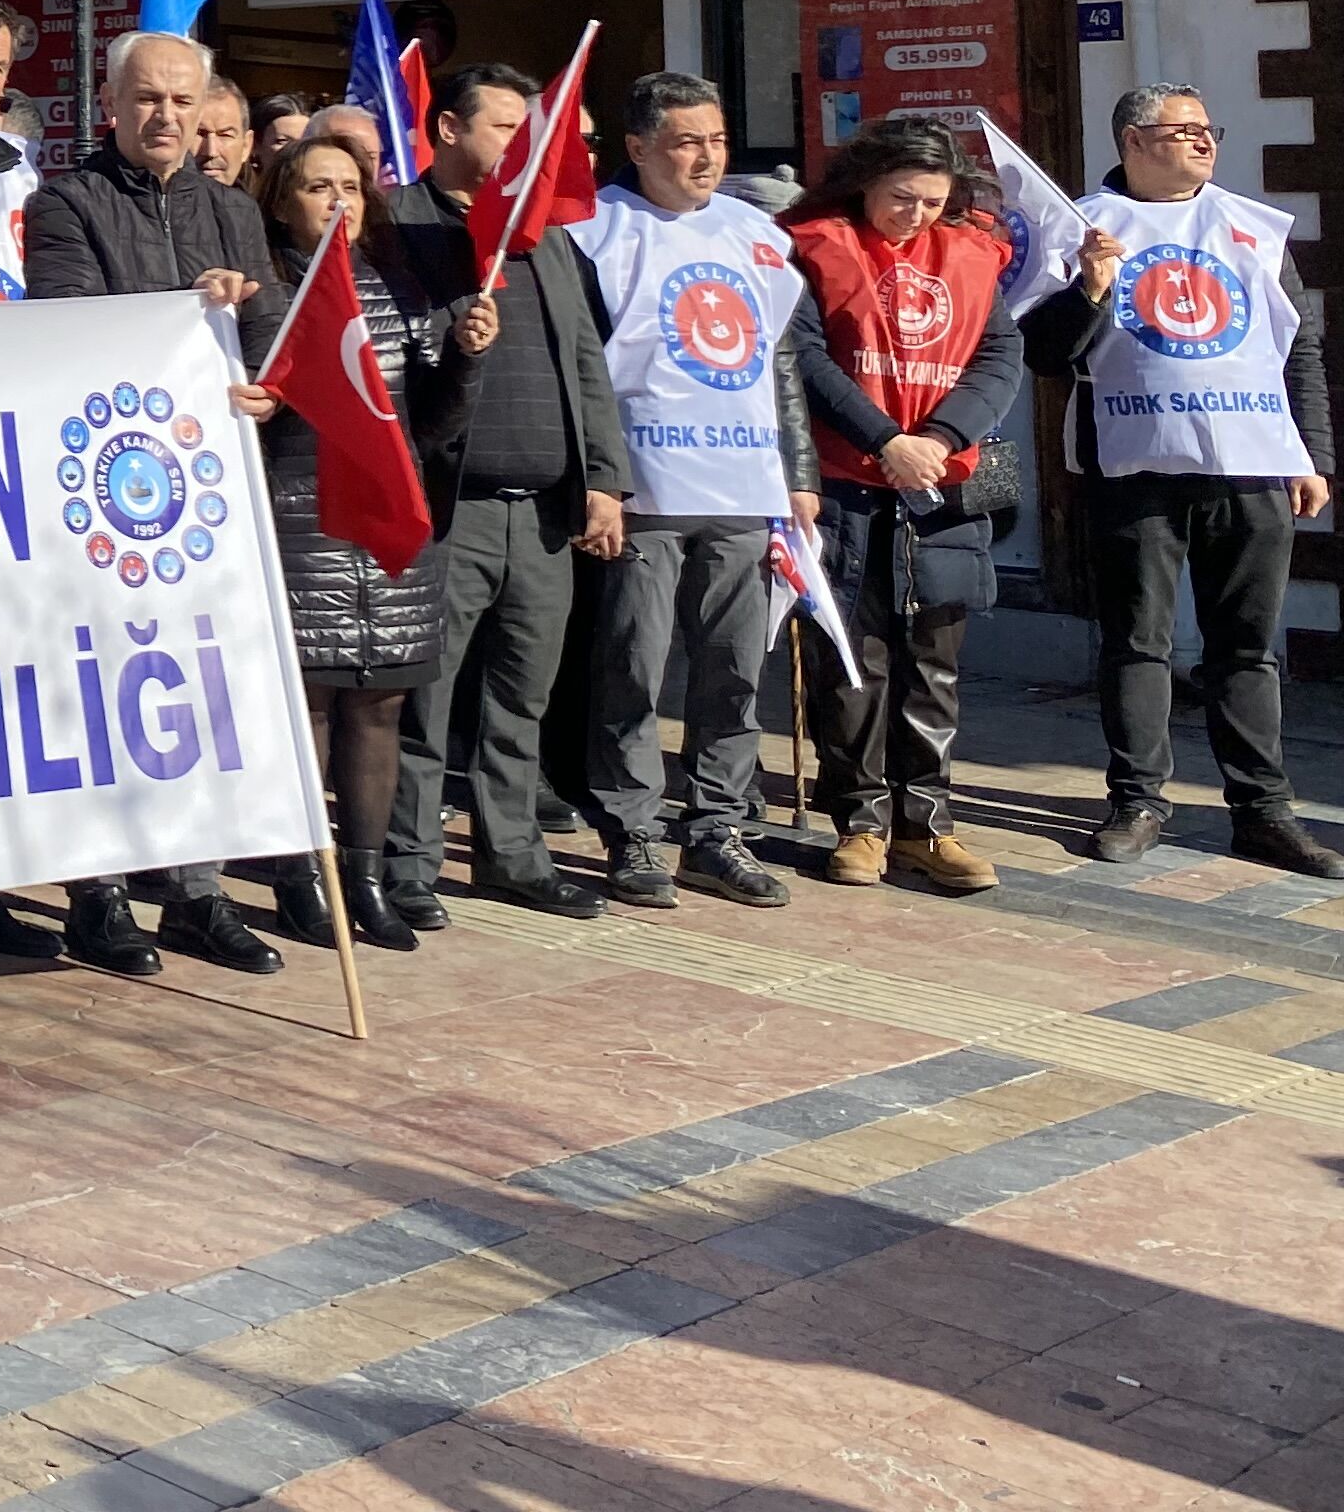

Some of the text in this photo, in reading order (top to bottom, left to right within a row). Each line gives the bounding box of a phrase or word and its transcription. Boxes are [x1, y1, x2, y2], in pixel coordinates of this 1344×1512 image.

[829, 2, 865, 14] Peşin
[868, 0, 902, 13] Fiyat
[1089, 9, 1111, 26] 43
[876, 24, 994, 41] SAMSUNG S25 FE
[900, 89, 973, 102] IPHONE 13
[1169, 340, 1223, 356] 1992
[708, 370, 752, 386] 1992
[1104, 384, 1284, 416] TÜRK SAĞLIK-SEN
[632, 419, 698, 448] TÜRK
[96, 439, 122, 508] TÜRKİYE
[132, 522, 164, 537] 1992
